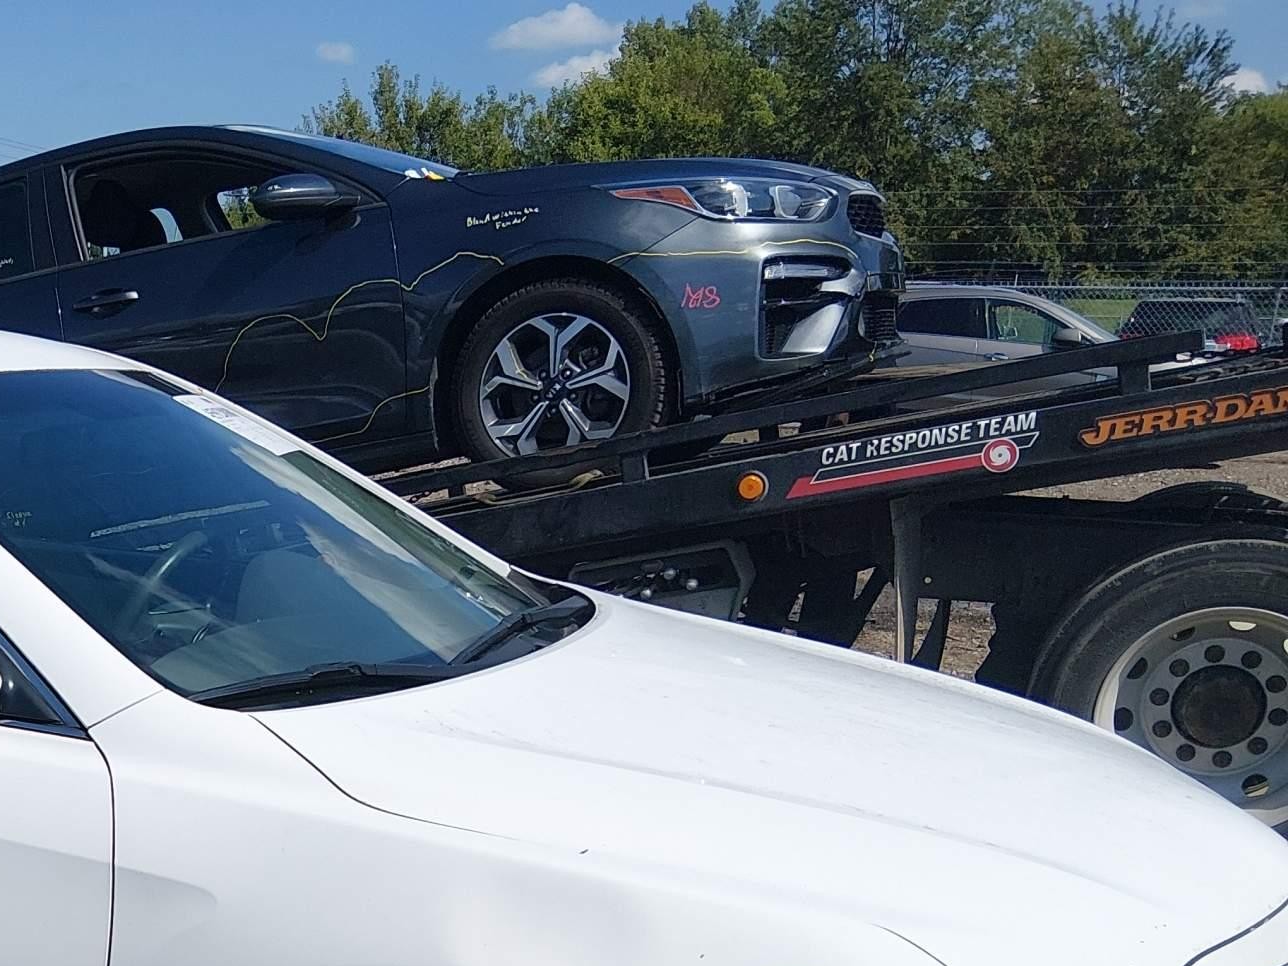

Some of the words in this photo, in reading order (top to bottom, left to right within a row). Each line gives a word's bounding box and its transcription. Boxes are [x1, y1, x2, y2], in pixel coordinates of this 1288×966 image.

[820, 442, 863, 466] CAT
[865, 424, 972, 459] RESPONSE
[976, 411, 1038, 440] TEAM
[1079, 385, 1288, 448] JERR-DA
